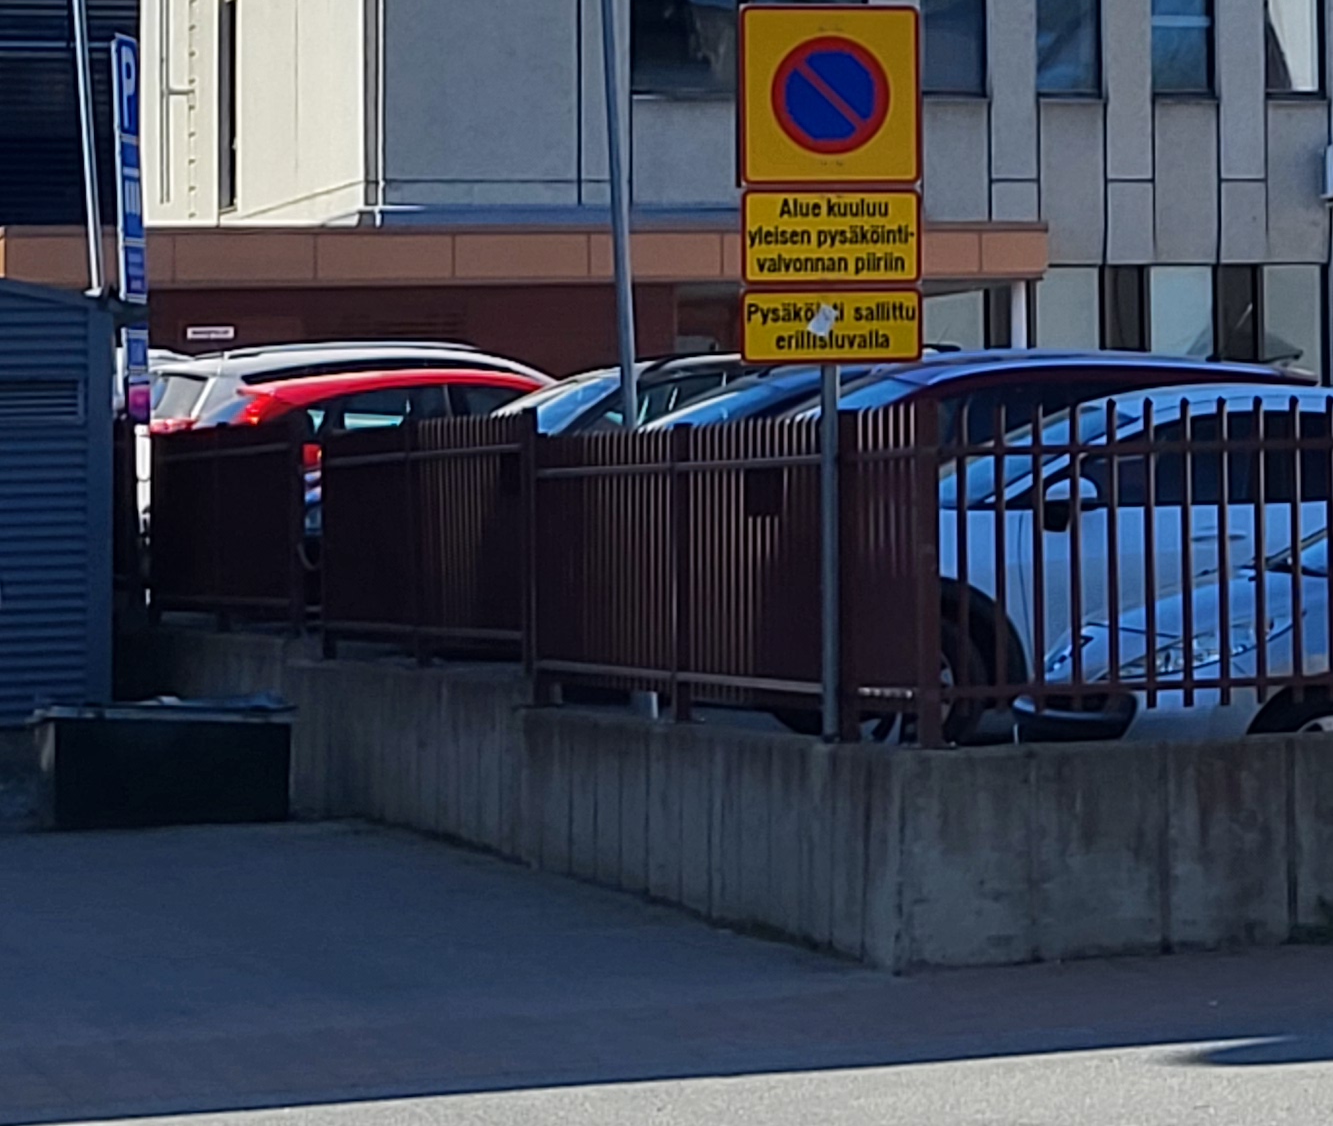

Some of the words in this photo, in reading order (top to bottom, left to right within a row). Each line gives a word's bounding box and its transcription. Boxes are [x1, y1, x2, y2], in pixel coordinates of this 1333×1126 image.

[121, 45, 136, 129] P
[779, 197, 822, 218] Alue
[826, 197, 889, 218] kuuluu
[748, 225, 811, 248] yleisen
[817, 224, 915, 248] pysäköinti-
[756, 253, 849, 273] valvonnan
[854, 252, 905, 275] piiriin
[747, 302, 845, 325] Pysäköiti
[853, 301, 916, 322] sallittu
[775, 329, 890, 350] erillisluvalla
